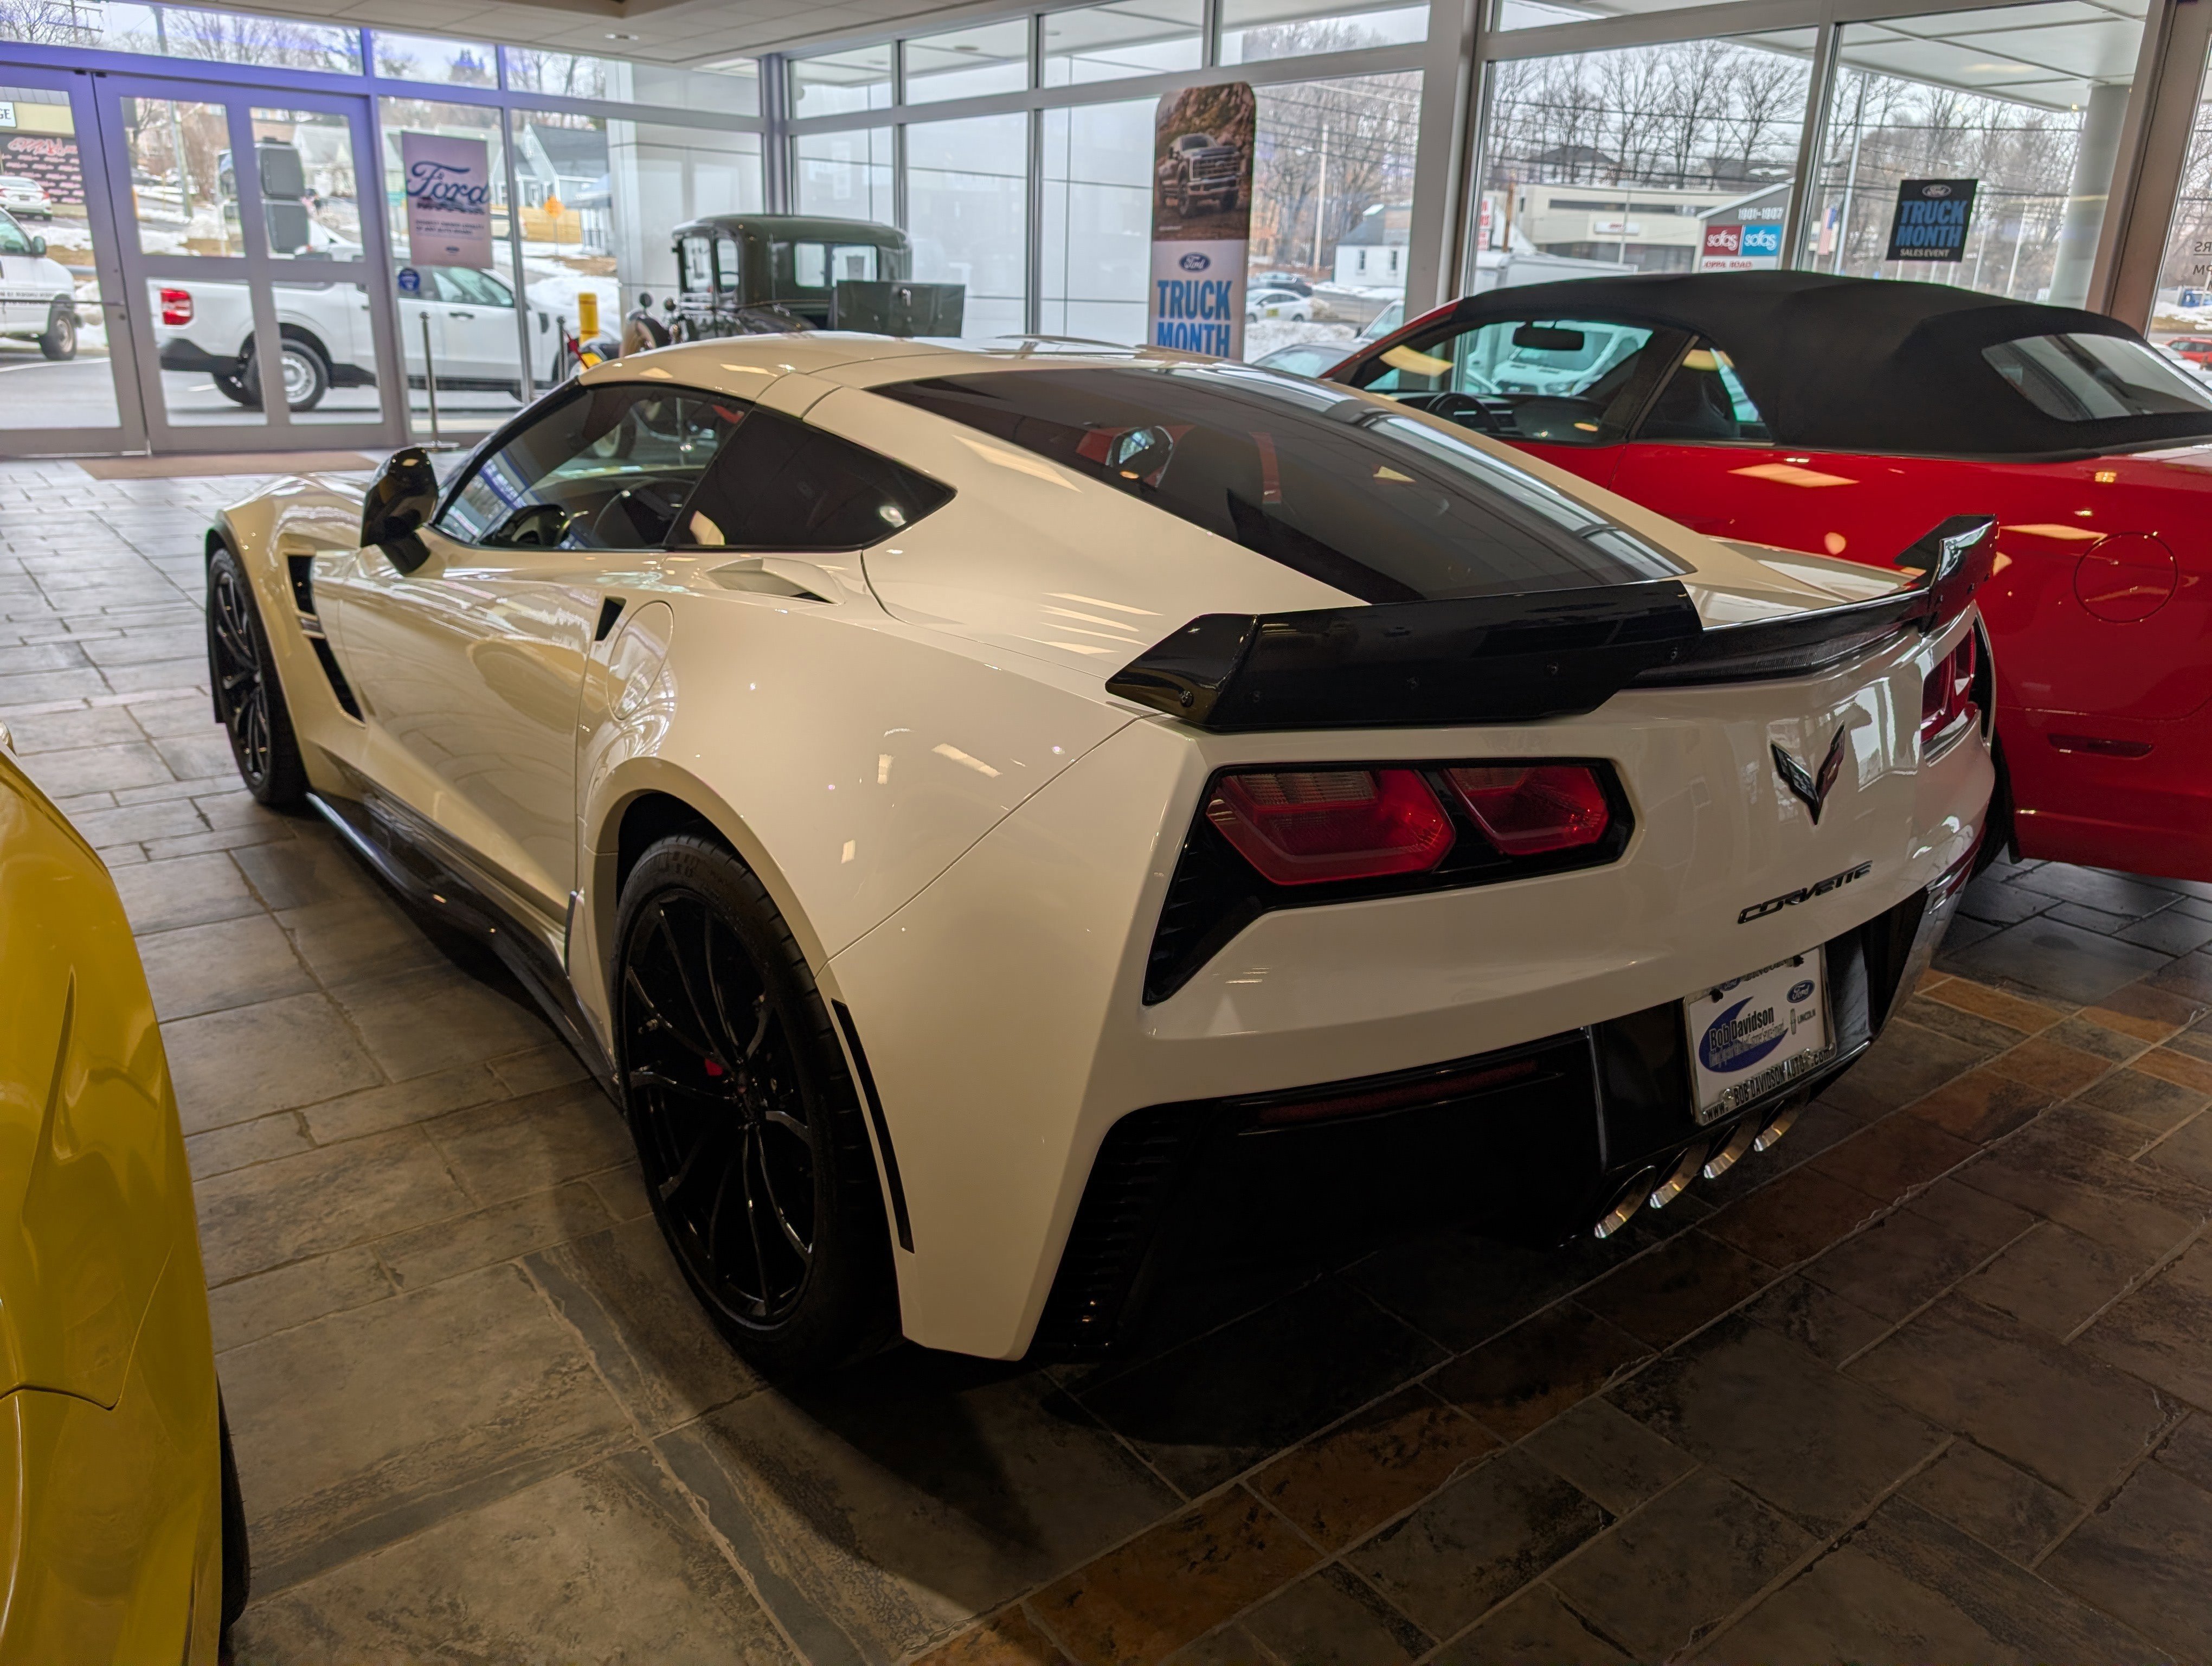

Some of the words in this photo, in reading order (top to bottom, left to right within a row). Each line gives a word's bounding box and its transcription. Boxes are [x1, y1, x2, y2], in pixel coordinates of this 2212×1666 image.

[406, 161, 490, 204] Ford
[1901, 200, 1968, 224] TRUCK
[1707, 230, 1738, 251] sofas
[1744, 229, 1777, 251] sofas
[1895, 225, 1963, 247] MONTH
[1899, 248, 1924, 257] SALES
[1924, 248, 1951, 258] EVENT
[1156, 279, 1233, 321] TRUCK
[1157, 322, 1230, 358] MONTH
[1737, 860, 1873, 924] CORVETTE
[1709, 1023, 1730, 1050] Bob
[1730, 1007, 1774, 1040] Davidson
[1749, 1066, 1786, 1098] DAVIDSON
